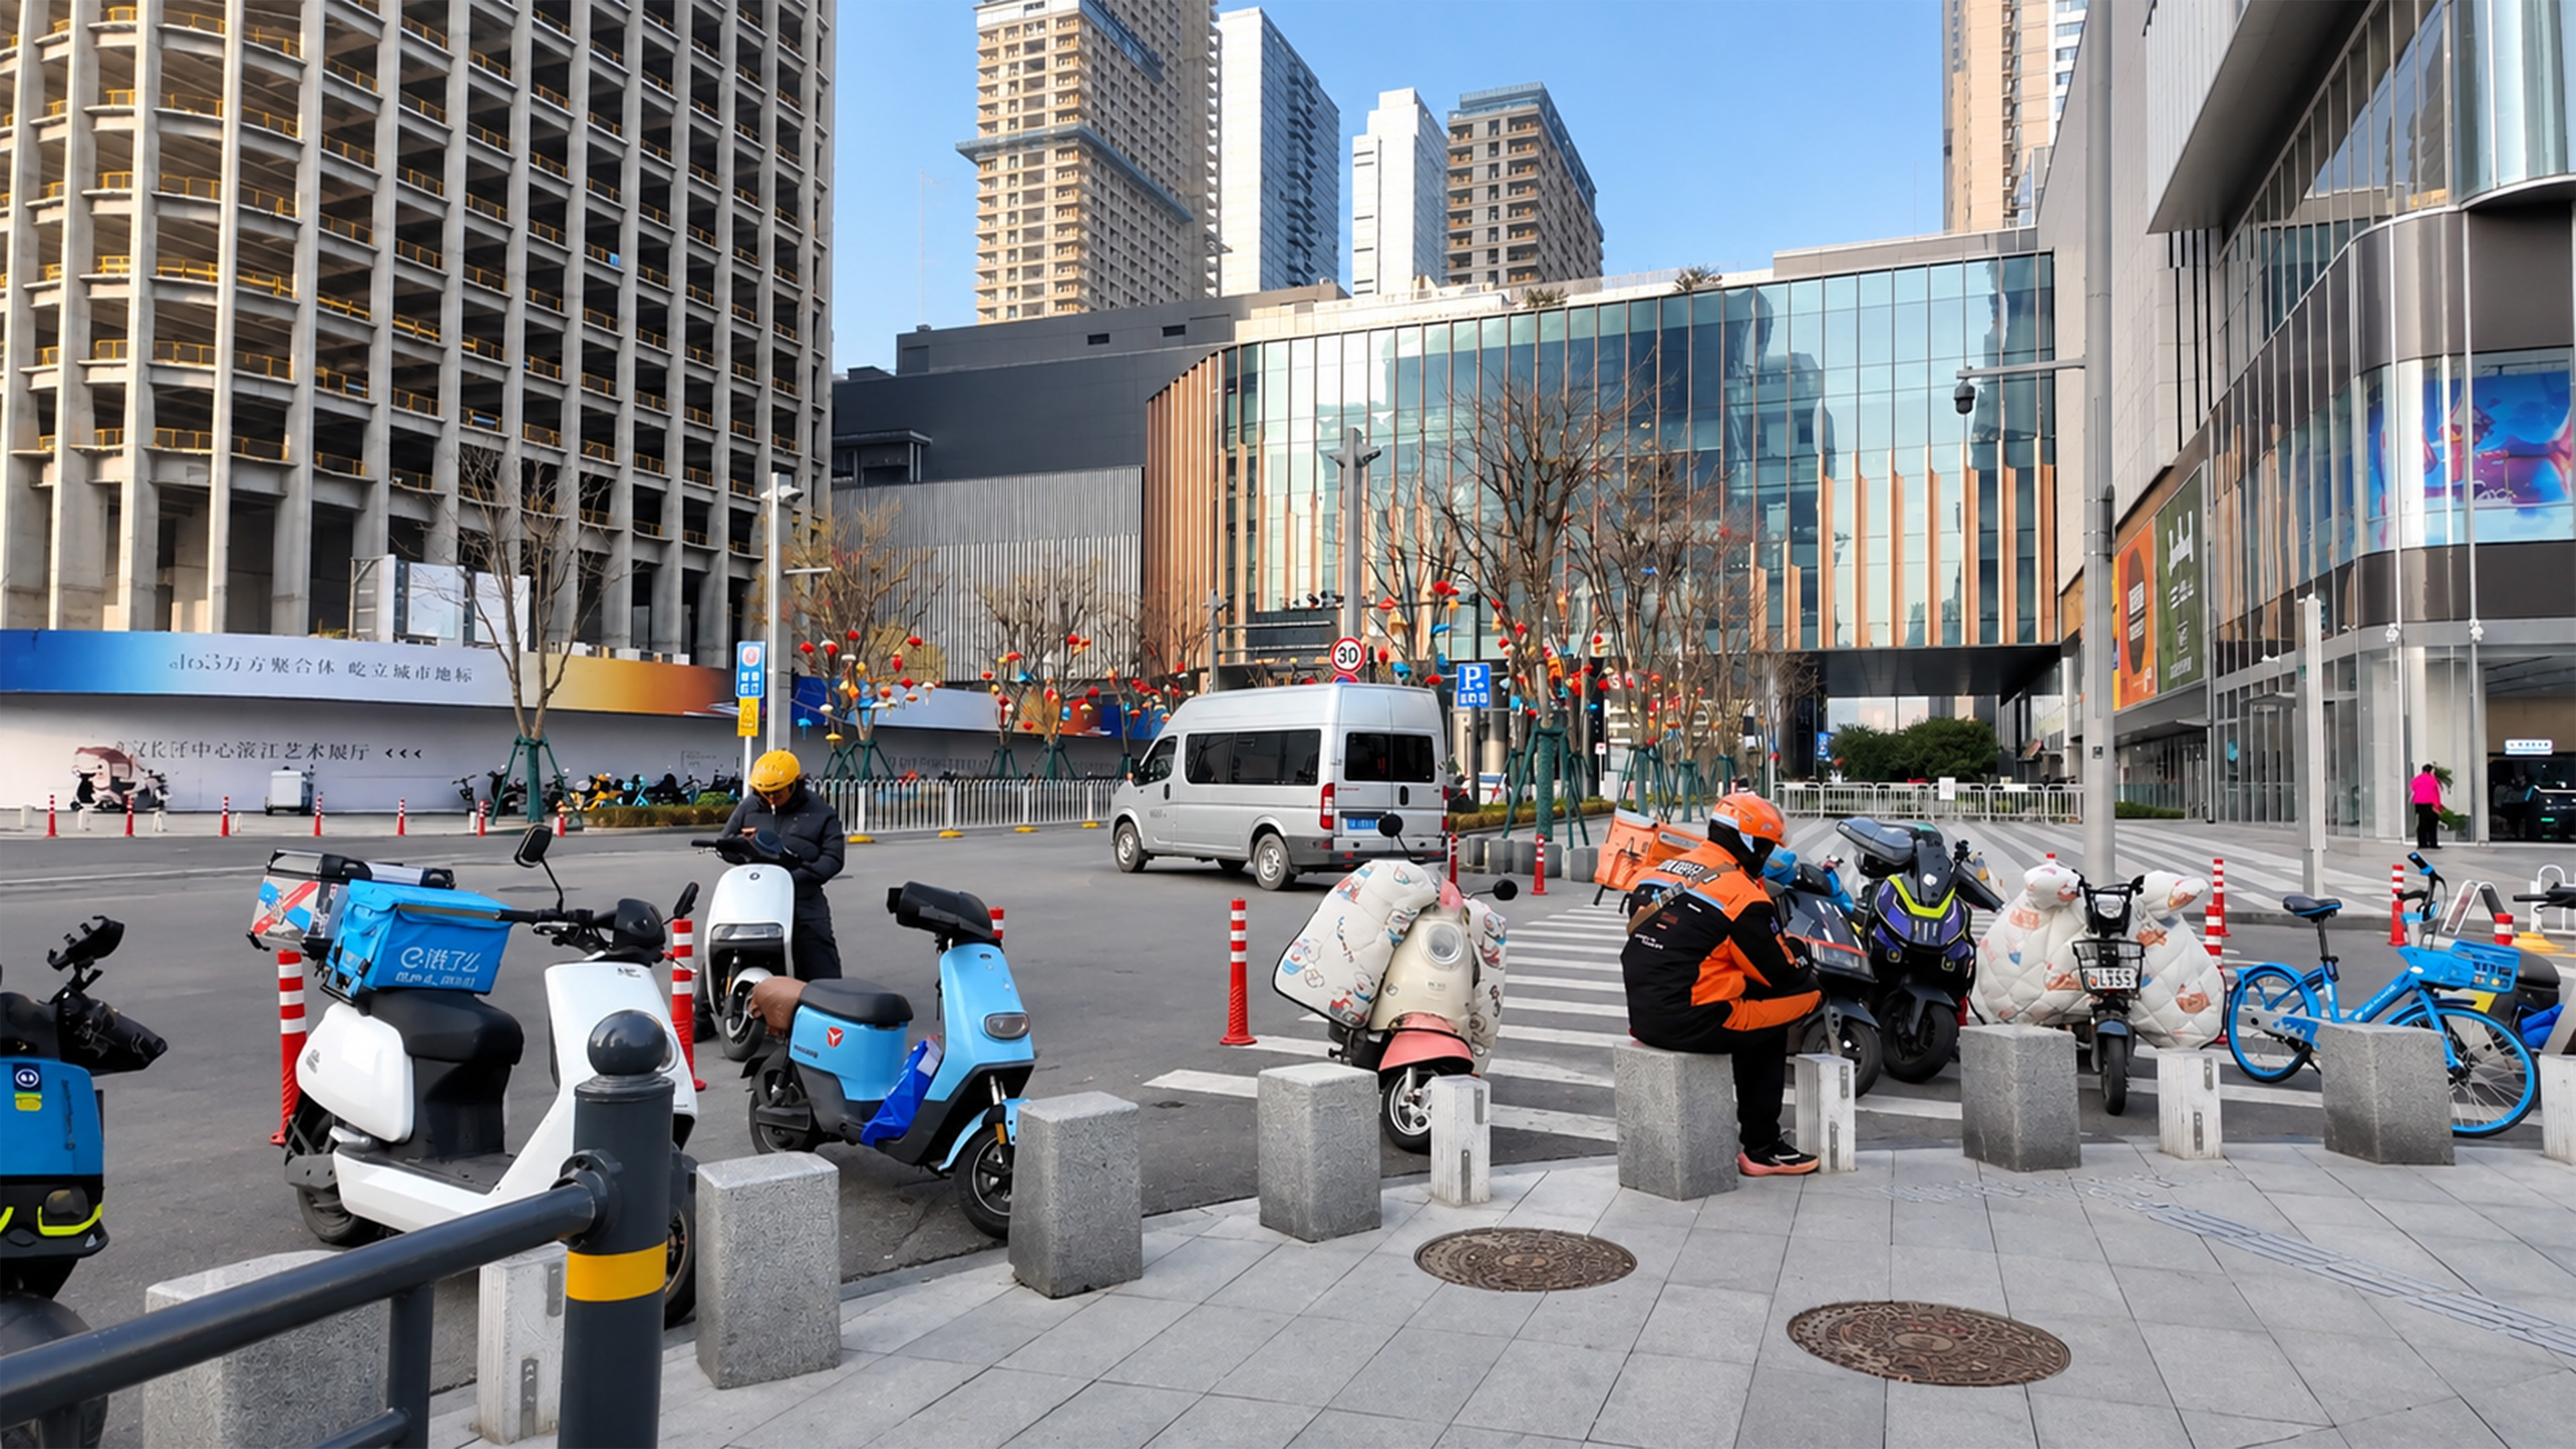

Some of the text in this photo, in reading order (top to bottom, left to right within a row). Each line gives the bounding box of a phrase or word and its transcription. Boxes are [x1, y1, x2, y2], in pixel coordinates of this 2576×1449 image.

[1338, 646, 1358, 664] 30
[347, 661, 474, 683] 屹立城市地标
[1461, 666, 1482, 691] P
